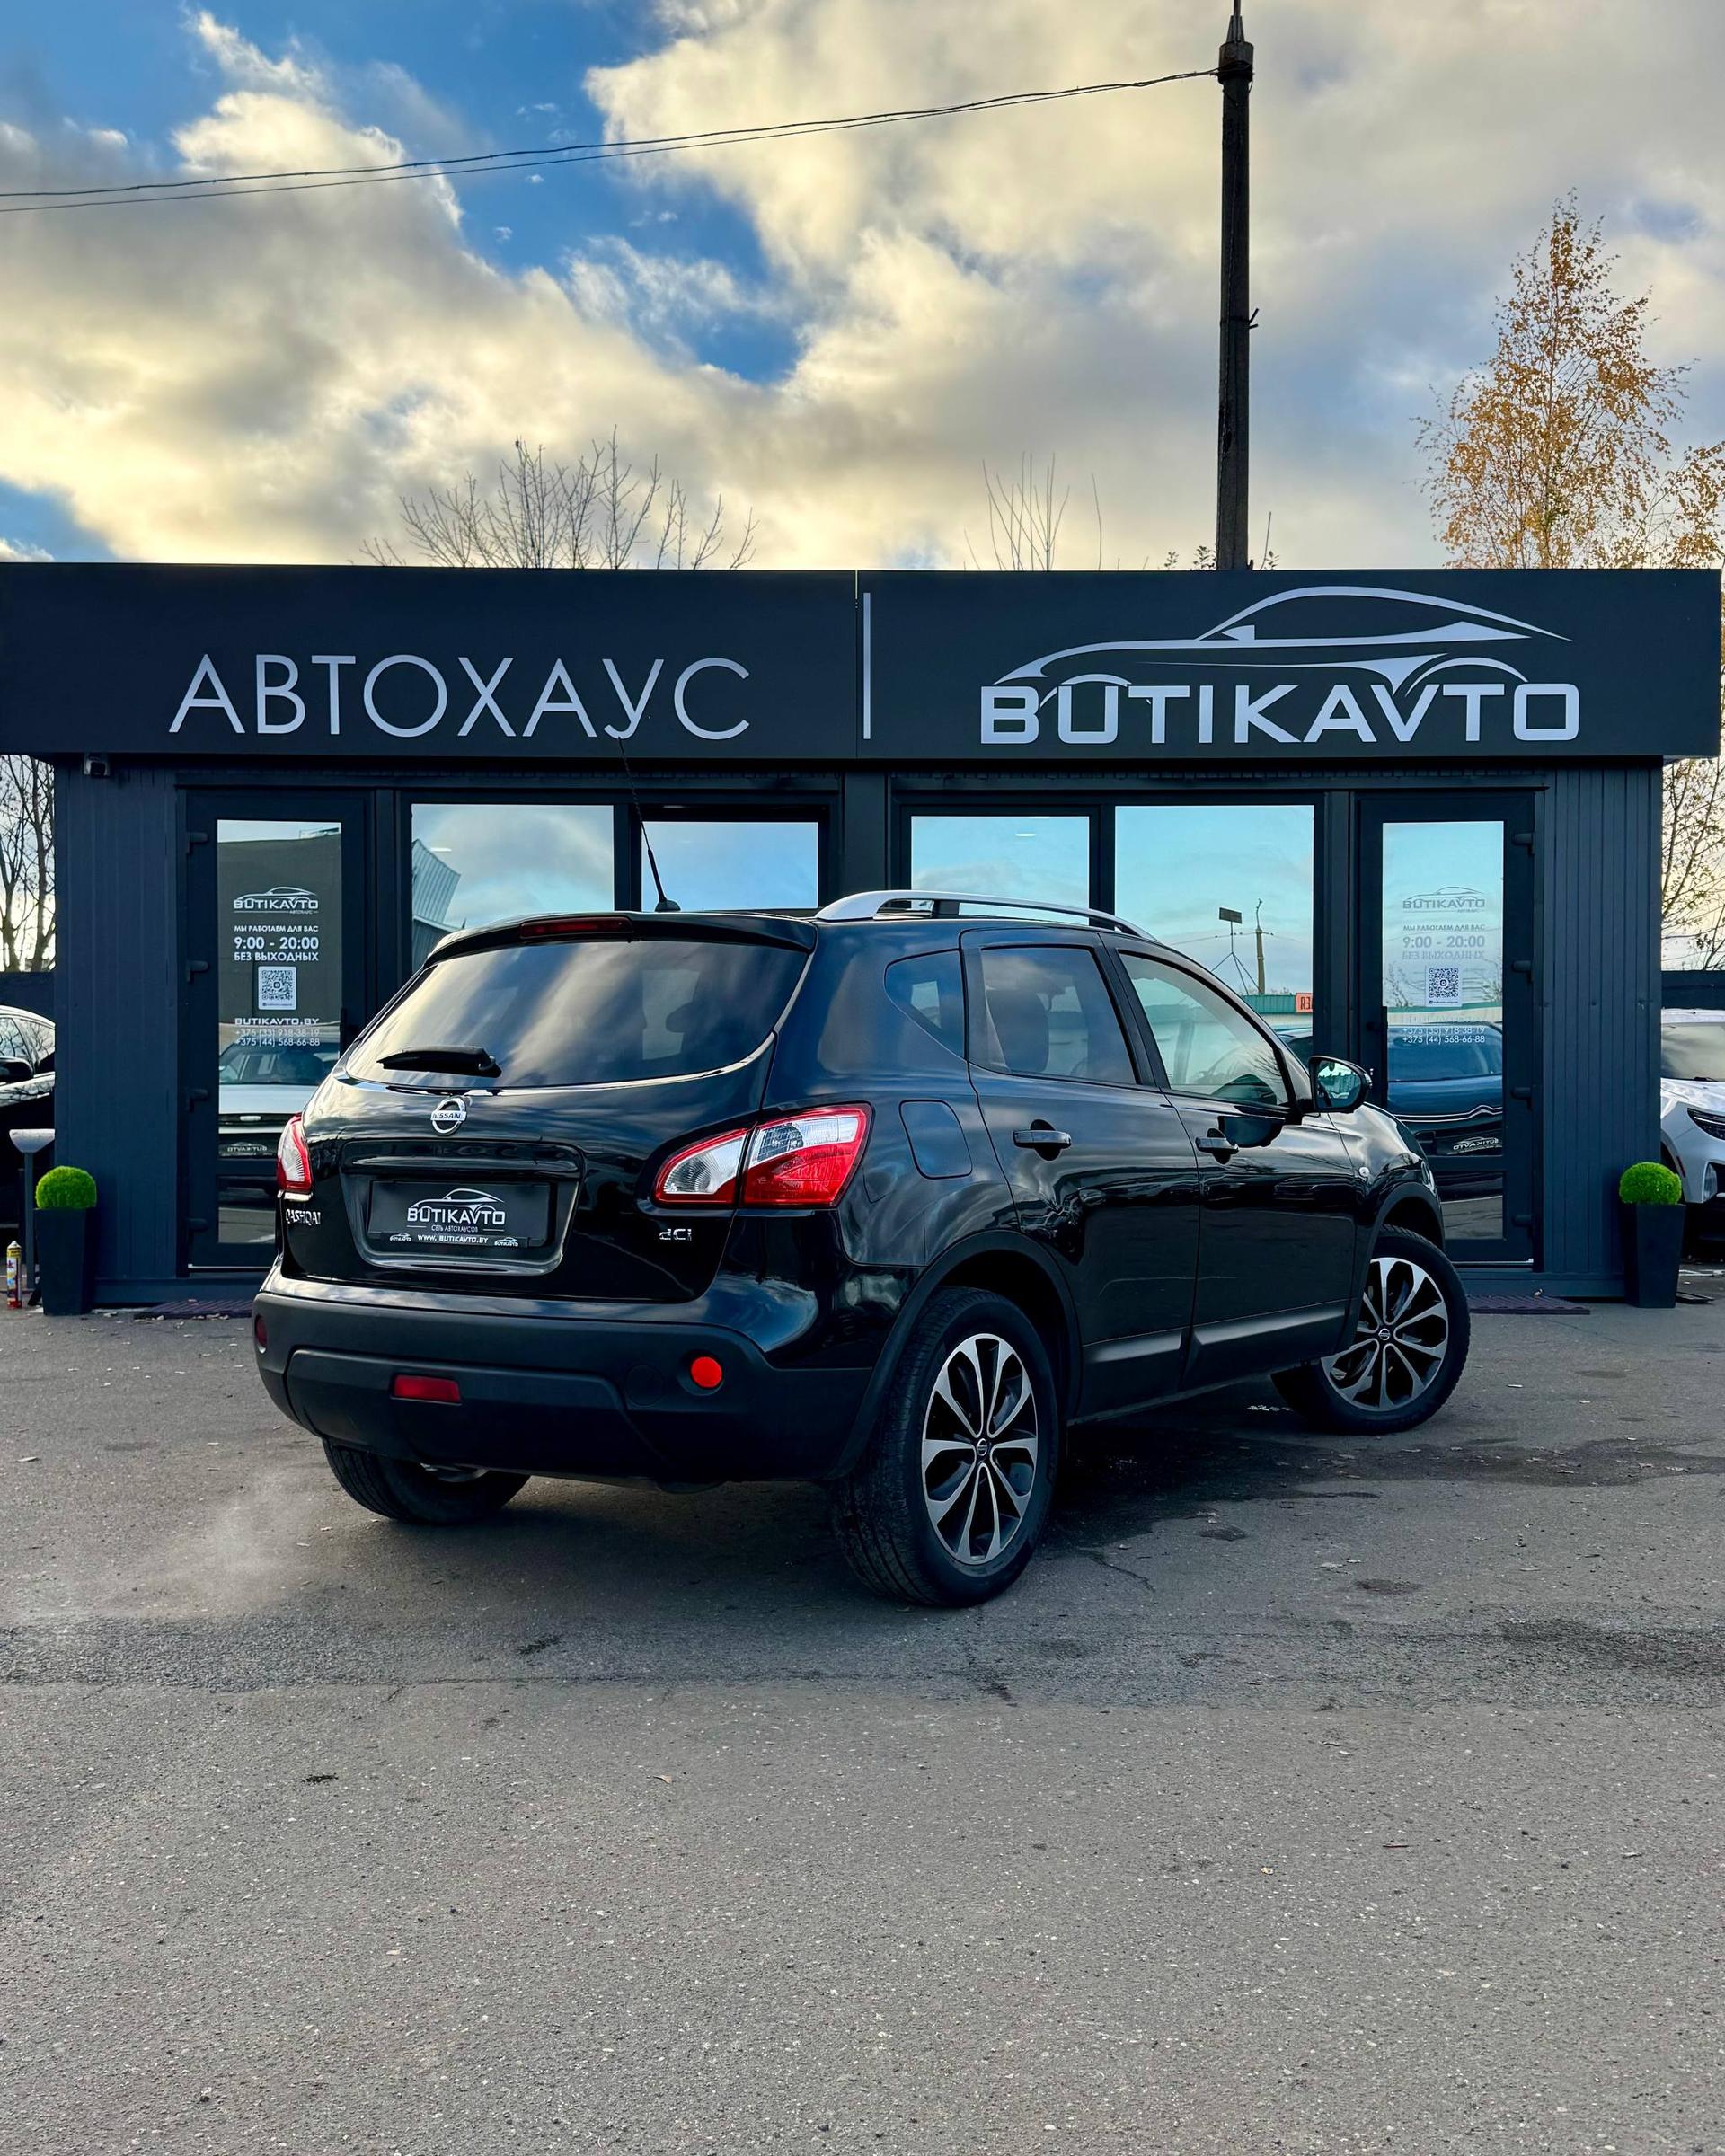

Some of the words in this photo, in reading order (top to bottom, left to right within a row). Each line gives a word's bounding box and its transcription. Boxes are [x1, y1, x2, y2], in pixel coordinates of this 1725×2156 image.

[168, 653, 750, 740] АВТОХАУС
[980, 682, 1579, 745] BUTIKAVTO
[234, 899, 319, 909] BUTIKAVTO
[1402, 899, 1485, 909] BUTIKAVTO
[234, 936, 265, 950] 9:00
[279, 936, 319, 950] 20:00
[1402, 936, 1432, 949] 9:00
[1446, 935, 1485, 949] 20:00
[234, 952, 252, 961] БЕЗ
[254, 952, 319, 962] ВЫХОДНЫХ
[235, 1038, 257, 1046] +375
[259, 1038, 276, 1047] (44)
[278, 1038, 320, 1046] 568-66-88
[1426, 1035, 1442, 1045] (44)
[1444, 1035, 1486, 1043] 568-66-88
[286, 1208, 321, 1226] QASHQAI
[407, 1207, 506, 1225] BUTIKAVTO
[444, 1225, 478, 1233] АВТОХАУСОВ
[438, 1235, 489, 1244] BUTIKAVTO.BY
